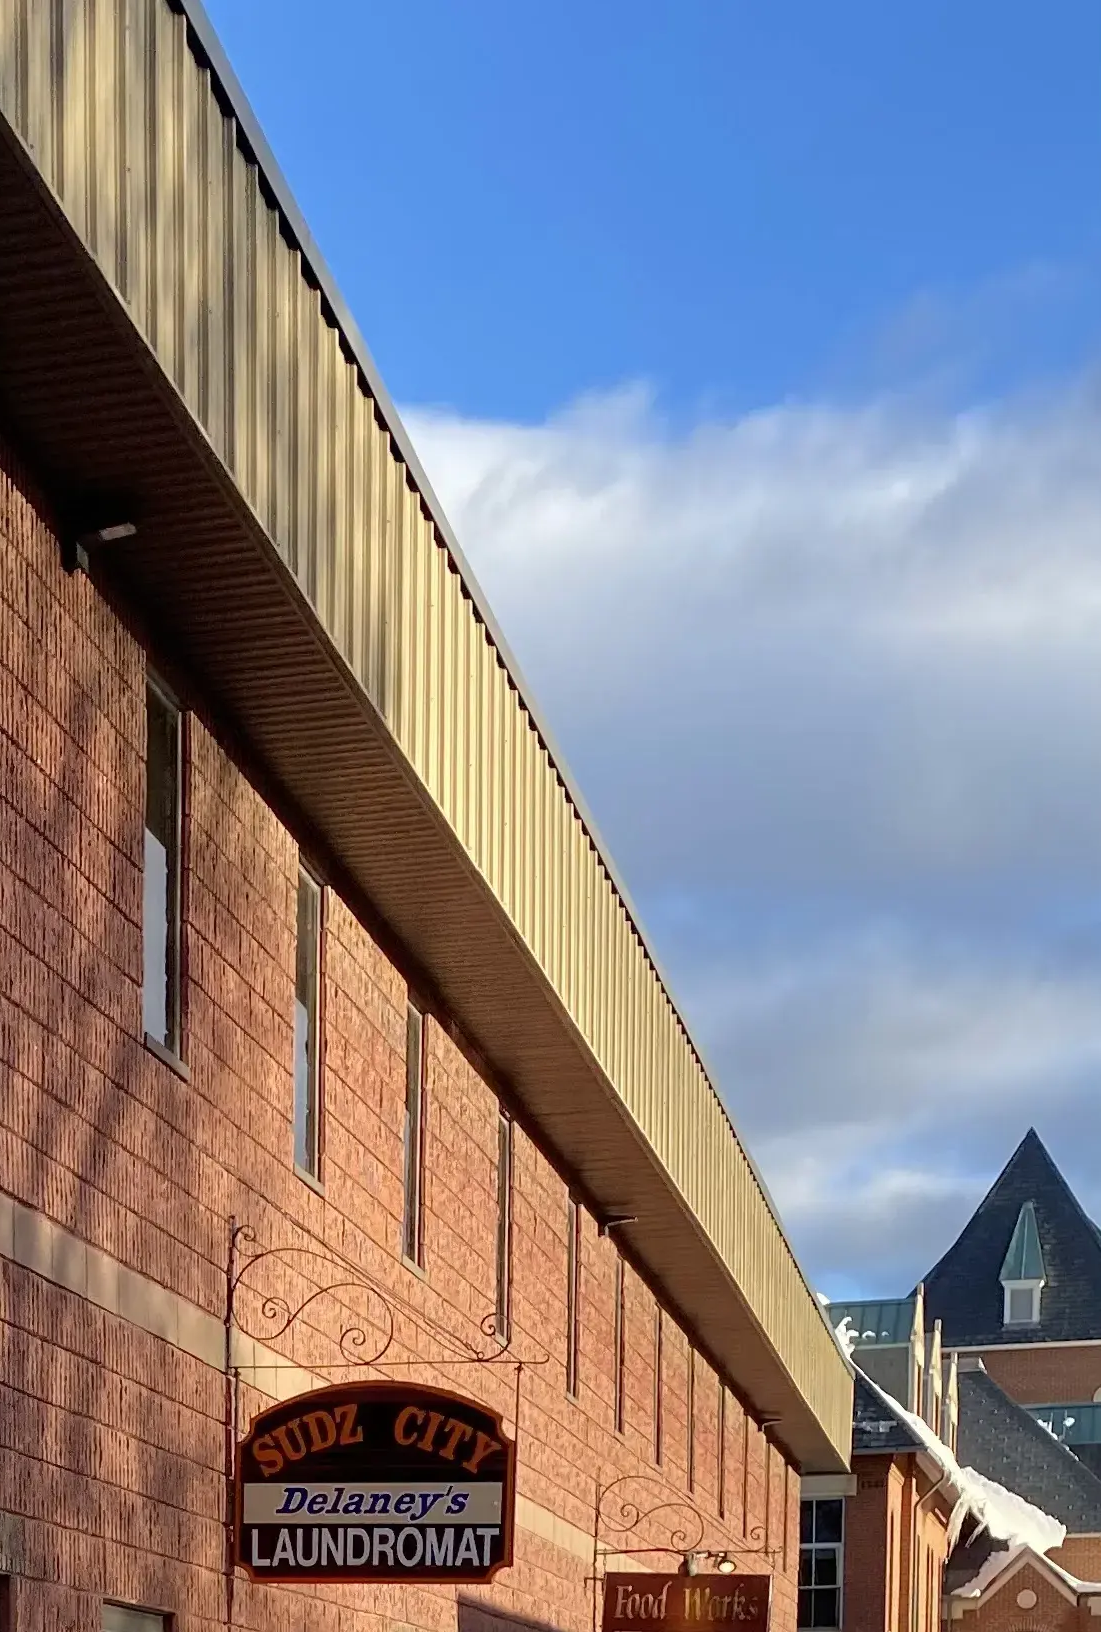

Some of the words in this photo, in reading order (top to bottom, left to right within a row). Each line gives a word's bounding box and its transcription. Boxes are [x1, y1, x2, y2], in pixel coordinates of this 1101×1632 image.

[252, 1403, 364, 1477] SUDZ
[394, 1406, 502, 1474] CITY
[275, 1485, 470, 1521] Delaney's
[251, 1527, 500, 1567] LAUNDROMAT
[614, 1580, 673, 1620] Food
[683, 1582, 759, 1622] Works
